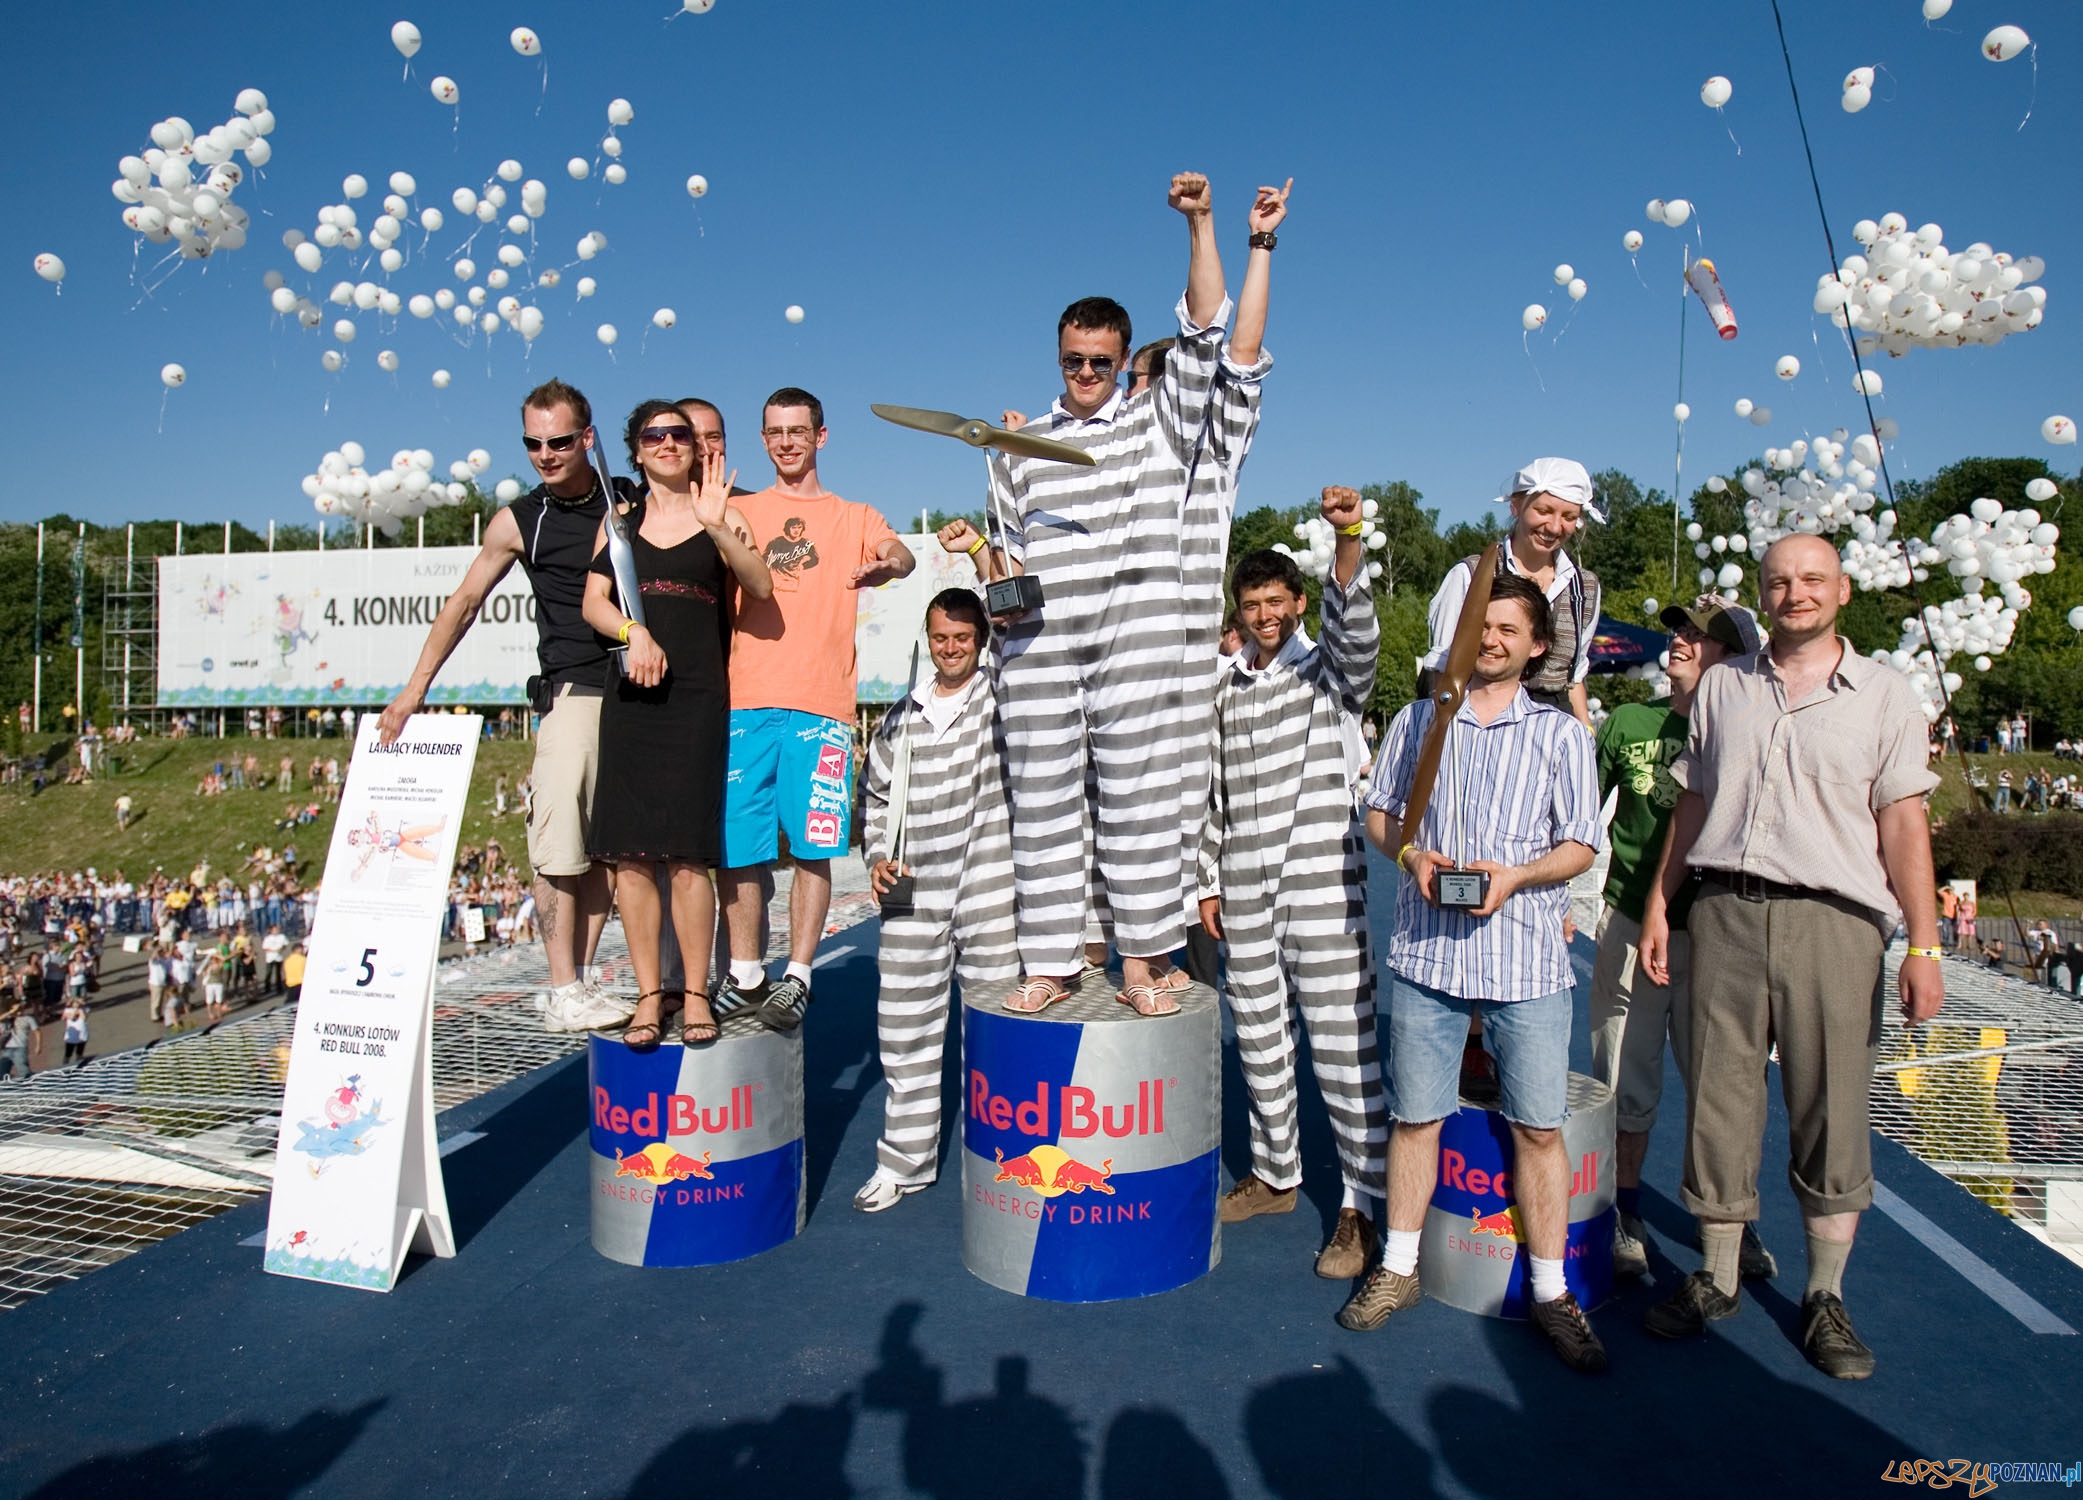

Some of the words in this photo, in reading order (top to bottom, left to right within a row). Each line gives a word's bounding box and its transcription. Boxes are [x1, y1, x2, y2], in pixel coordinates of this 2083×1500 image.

[324, 598, 345, 626] 4.
[412, 743, 463, 756] HOLENDER
[1458, 887, 1465, 898] 3
[355, 948, 378, 987] 5
[313, 1021, 322, 1035] 4.
[323, 1022, 366, 1039] KONKURS
[367, 1025, 401, 1042] LOTÓW
[320, 1039, 338, 1053] RED
[339, 1040, 361, 1055] BULL
[363, 1043, 387, 1058] 2008.
[594, 1085, 659, 1138] Red
[667, 1084, 754, 1137] Bull
[970, 1068, 1049, 1138] Red
[1060, 1078, 1164, 1139] Bull
[601, 1180, 668, 1206] ENERGY
[676, 1182, 746, 1206] DRINK
[975, 1184, 1059, 1224] ENERGY
[1069, 1200, 1152, 1225] DRINK
